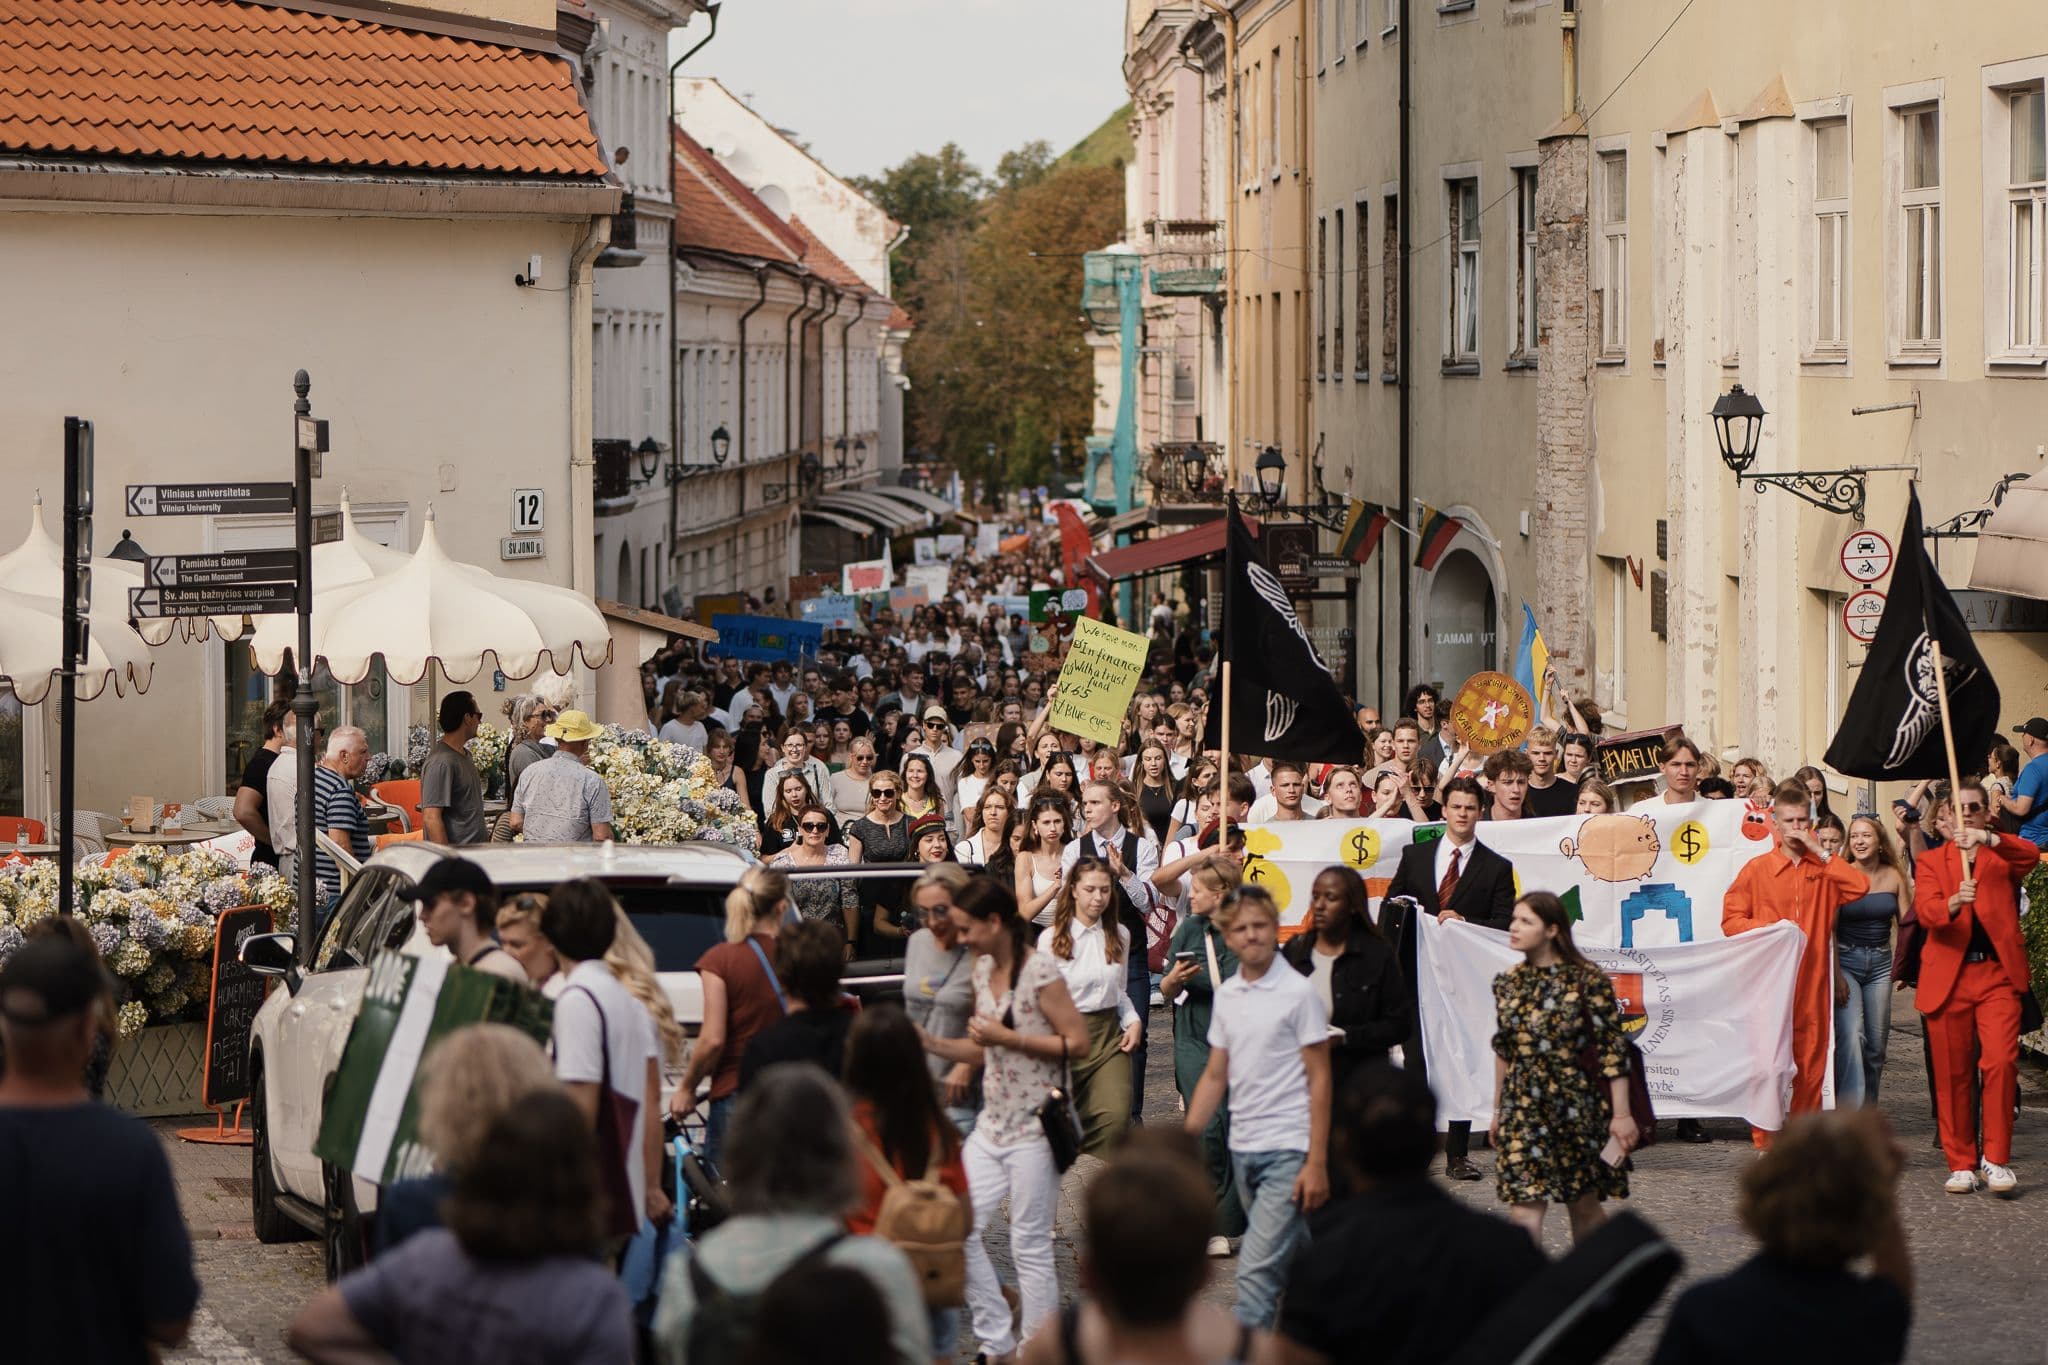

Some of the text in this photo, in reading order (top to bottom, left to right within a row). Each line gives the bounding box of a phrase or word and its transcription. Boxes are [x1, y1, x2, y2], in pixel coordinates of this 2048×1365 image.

[160, 487, 251, 499] Vilniaus universitetas
[161, 503, 222, 513] Vilnius University
[518, 494, 539, 525] 12
[180, 556, 247, 569] Paminklas Gaonui
[181, 572, 244, 583] The Gaon Monument
[164, 589, 177, 600] Šv.
[179, 590, 199, 601] Jonų
[244, 587, 275, 599] varpinė
[165, 606, 177, 615] Sts
[201, 604, 225, 614] Church
[226, 603, 263, 613] Campanile
[1082, 622, 1099, 637] We
[1102, 668, 1127, 686] trust
[1064, 703, 1112, 732] Blue eyes
[217, 979, 263, 1008] HOMEMADE
